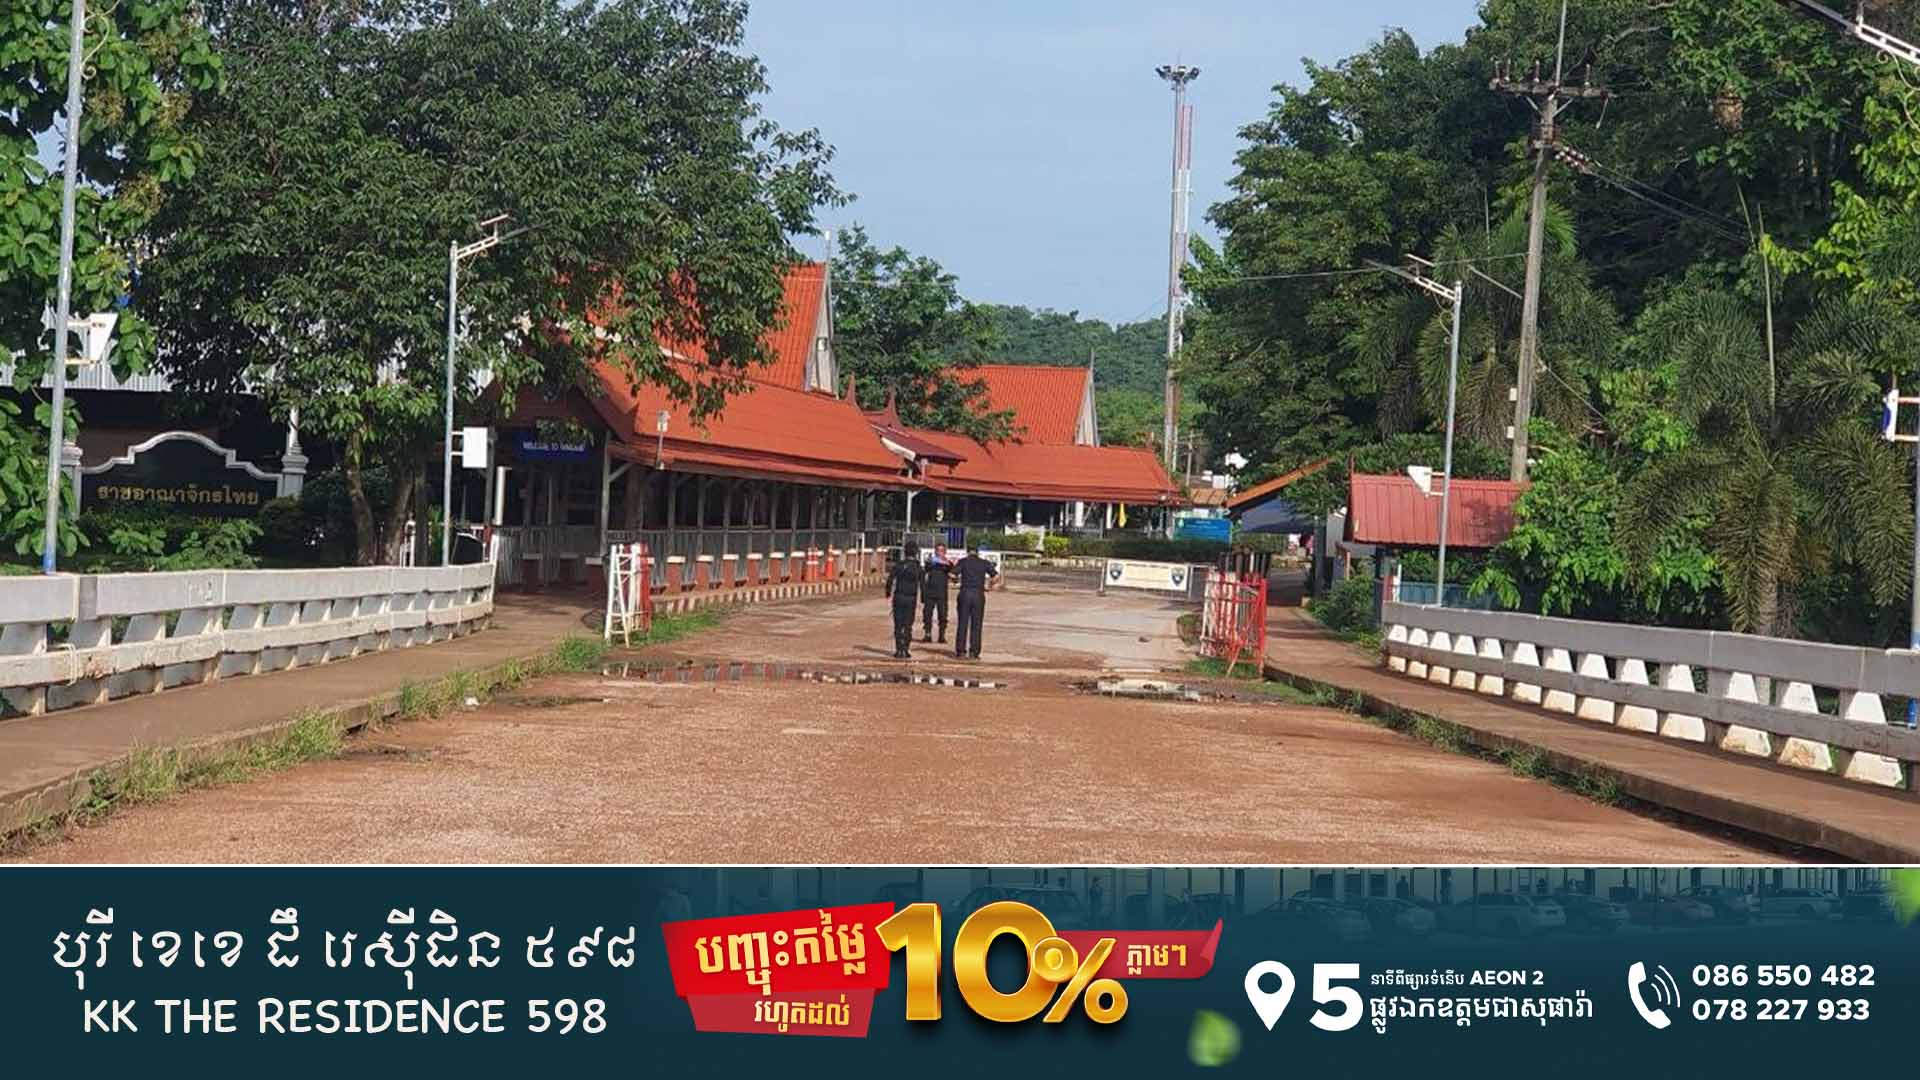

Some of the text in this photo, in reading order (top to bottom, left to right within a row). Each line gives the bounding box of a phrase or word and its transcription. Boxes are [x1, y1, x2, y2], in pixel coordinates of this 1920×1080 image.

[97, 483, 259, 506] ราชอาณาจักรไทย
